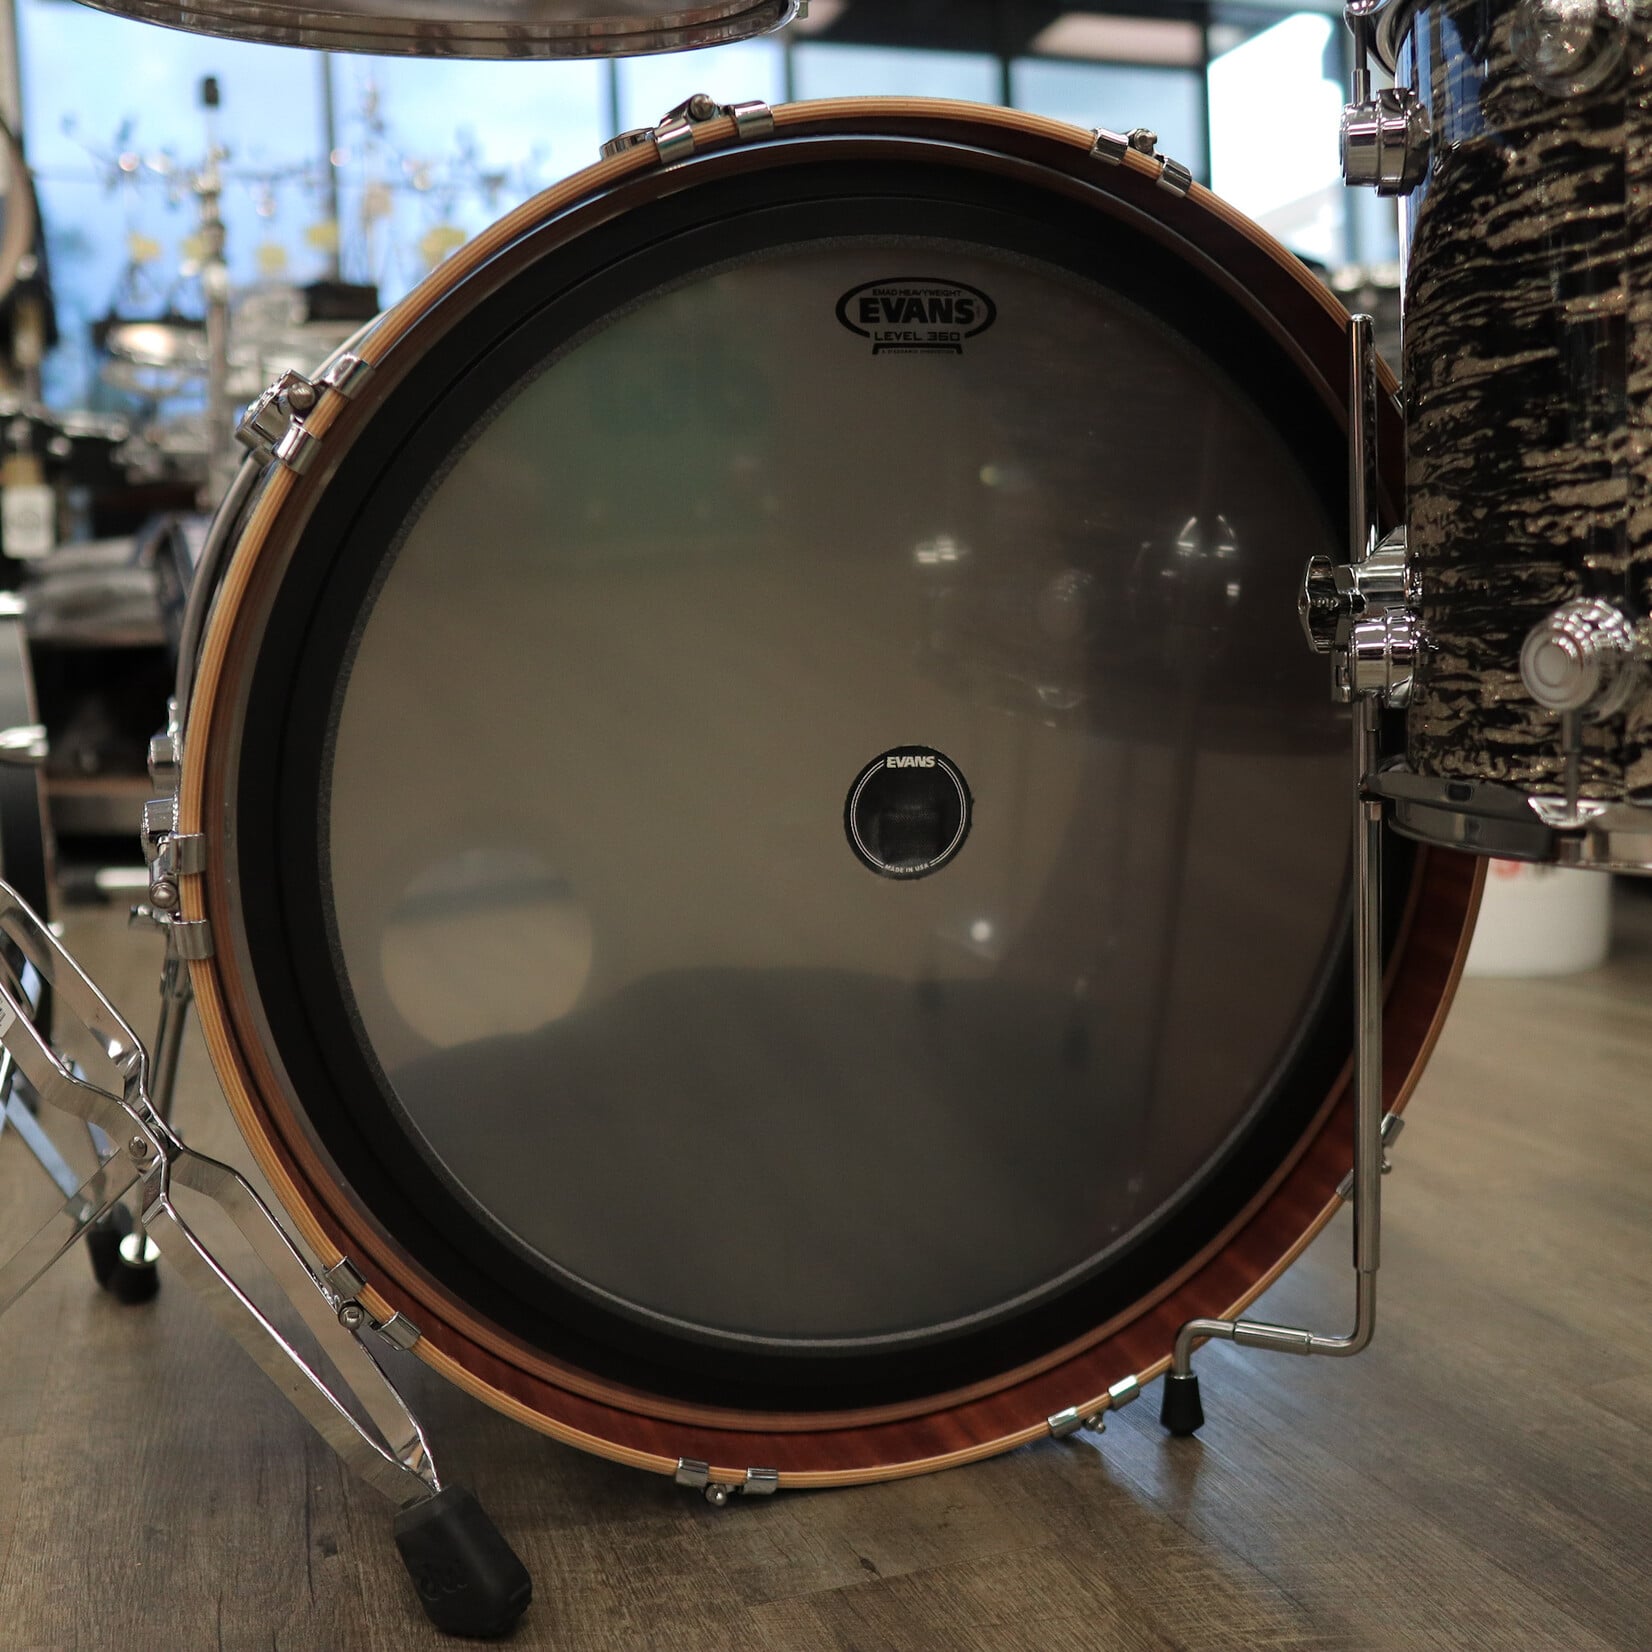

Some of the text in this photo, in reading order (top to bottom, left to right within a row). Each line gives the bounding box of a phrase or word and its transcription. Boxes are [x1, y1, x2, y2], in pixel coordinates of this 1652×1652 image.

[898, 289, 962, 297] HEAVYWEIGHT
[859, 298, 975, 324] EVANS
[874, 332, 961, 341] LEVEL 360
[886, 756, 936, 768] EVANS
[885, 864, 904, 873] MADE
[915, 863, 929, 872] USA
